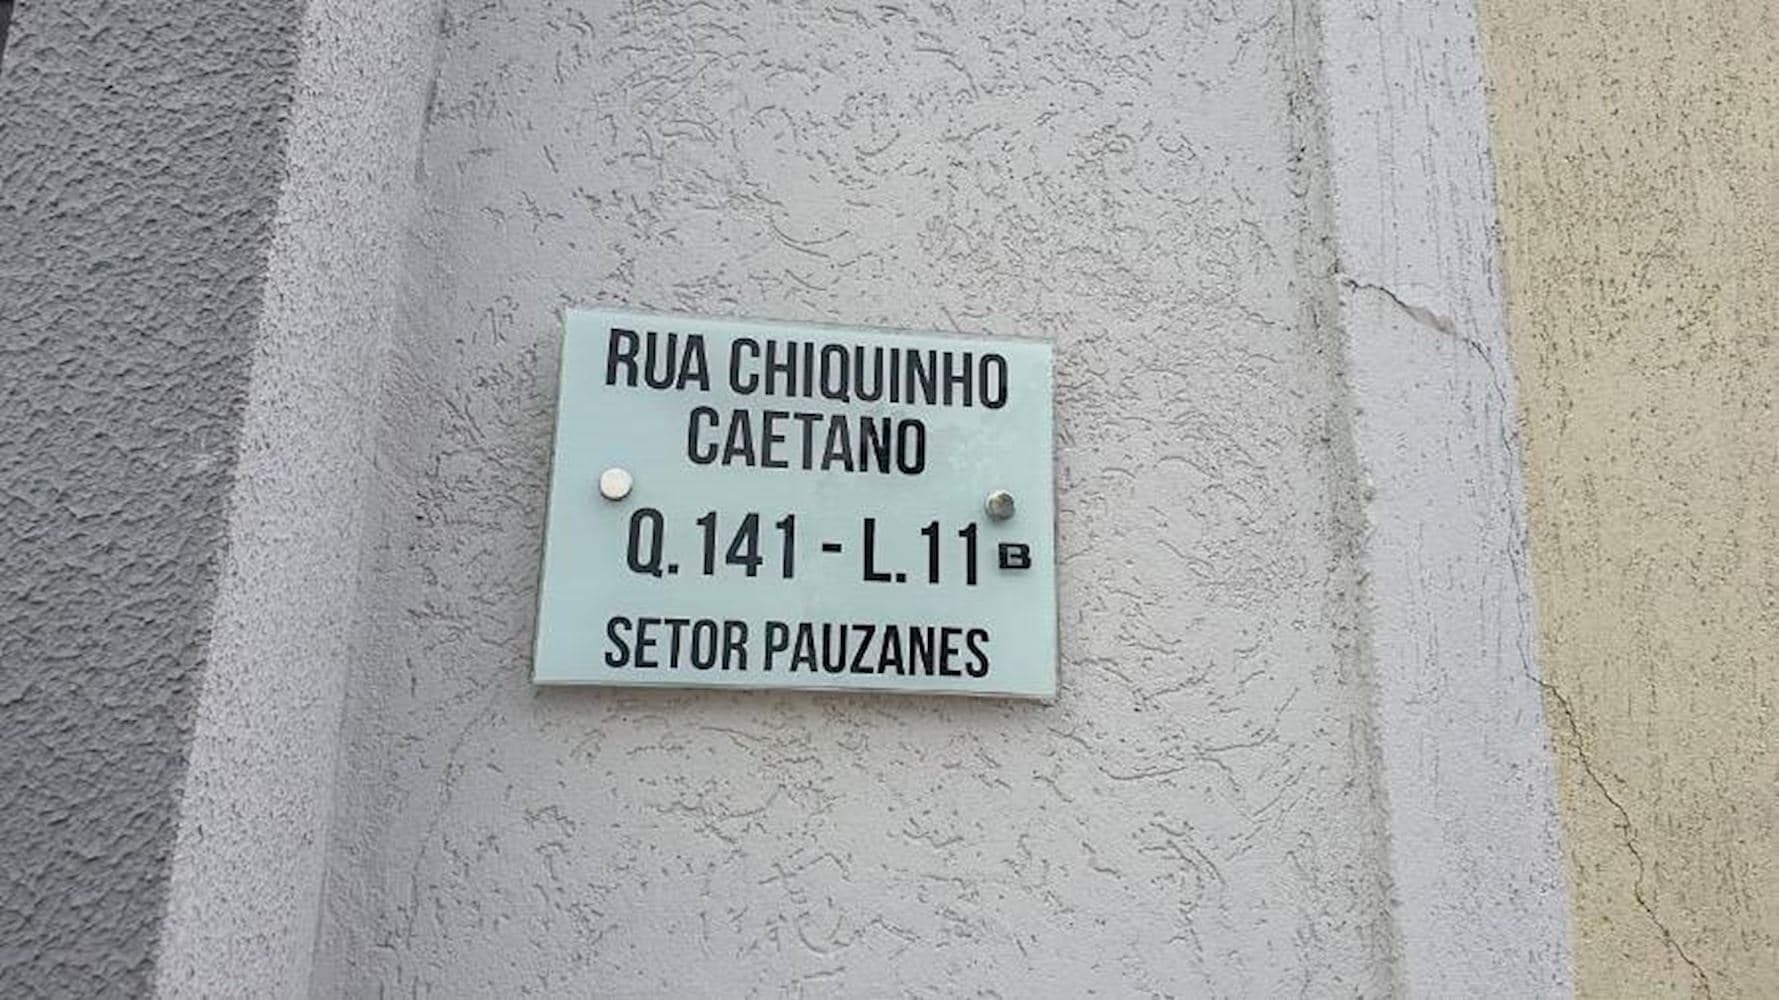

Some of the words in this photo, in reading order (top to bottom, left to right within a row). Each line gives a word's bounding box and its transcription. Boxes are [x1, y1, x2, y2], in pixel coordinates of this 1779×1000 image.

[605, 327, 710, 392] RUA
[729, 337, 1008, 410] CHIQUINHO
[687, 405, 926, 476] CAETANO
[604, 616, 749, 672] SETOR
[763, 620, 990, 679] PAUZANES
